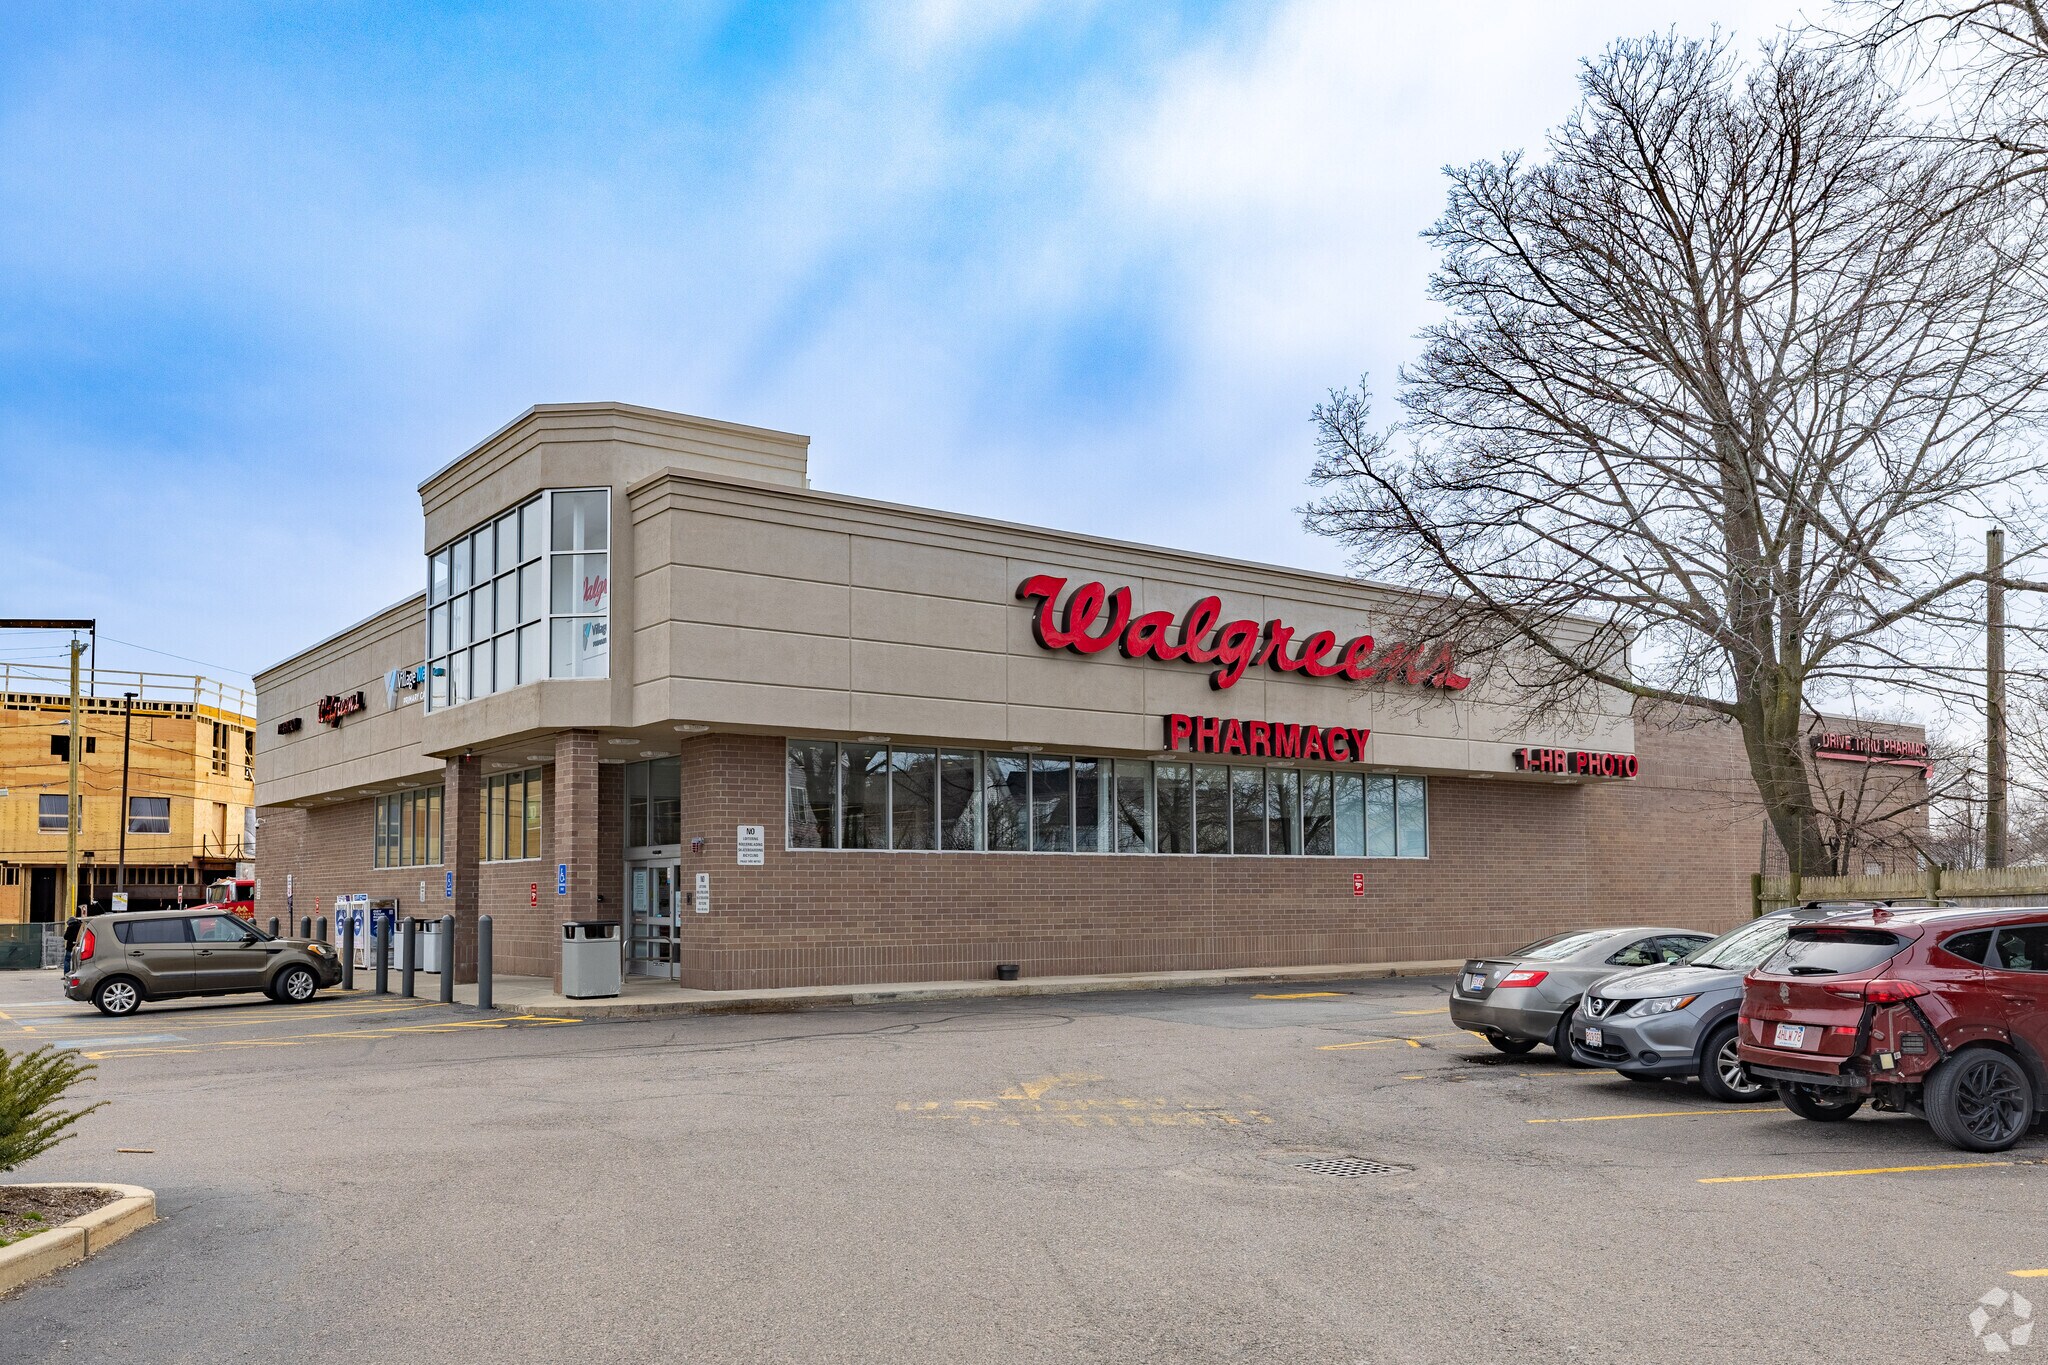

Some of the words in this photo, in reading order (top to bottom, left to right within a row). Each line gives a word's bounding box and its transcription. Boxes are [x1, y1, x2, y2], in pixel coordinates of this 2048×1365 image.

[1015, 574, 1472, 690] Walgreens
[1164, 713, 1371, 763] PHARMACY
[1822, 733, 1852, 751] DRIVE
[1884, 738, 1928, 758] PHARMAC
[1514, 748, 1567, 773] 1-HR
[1570, 751, 1639, 778] PHOTO
